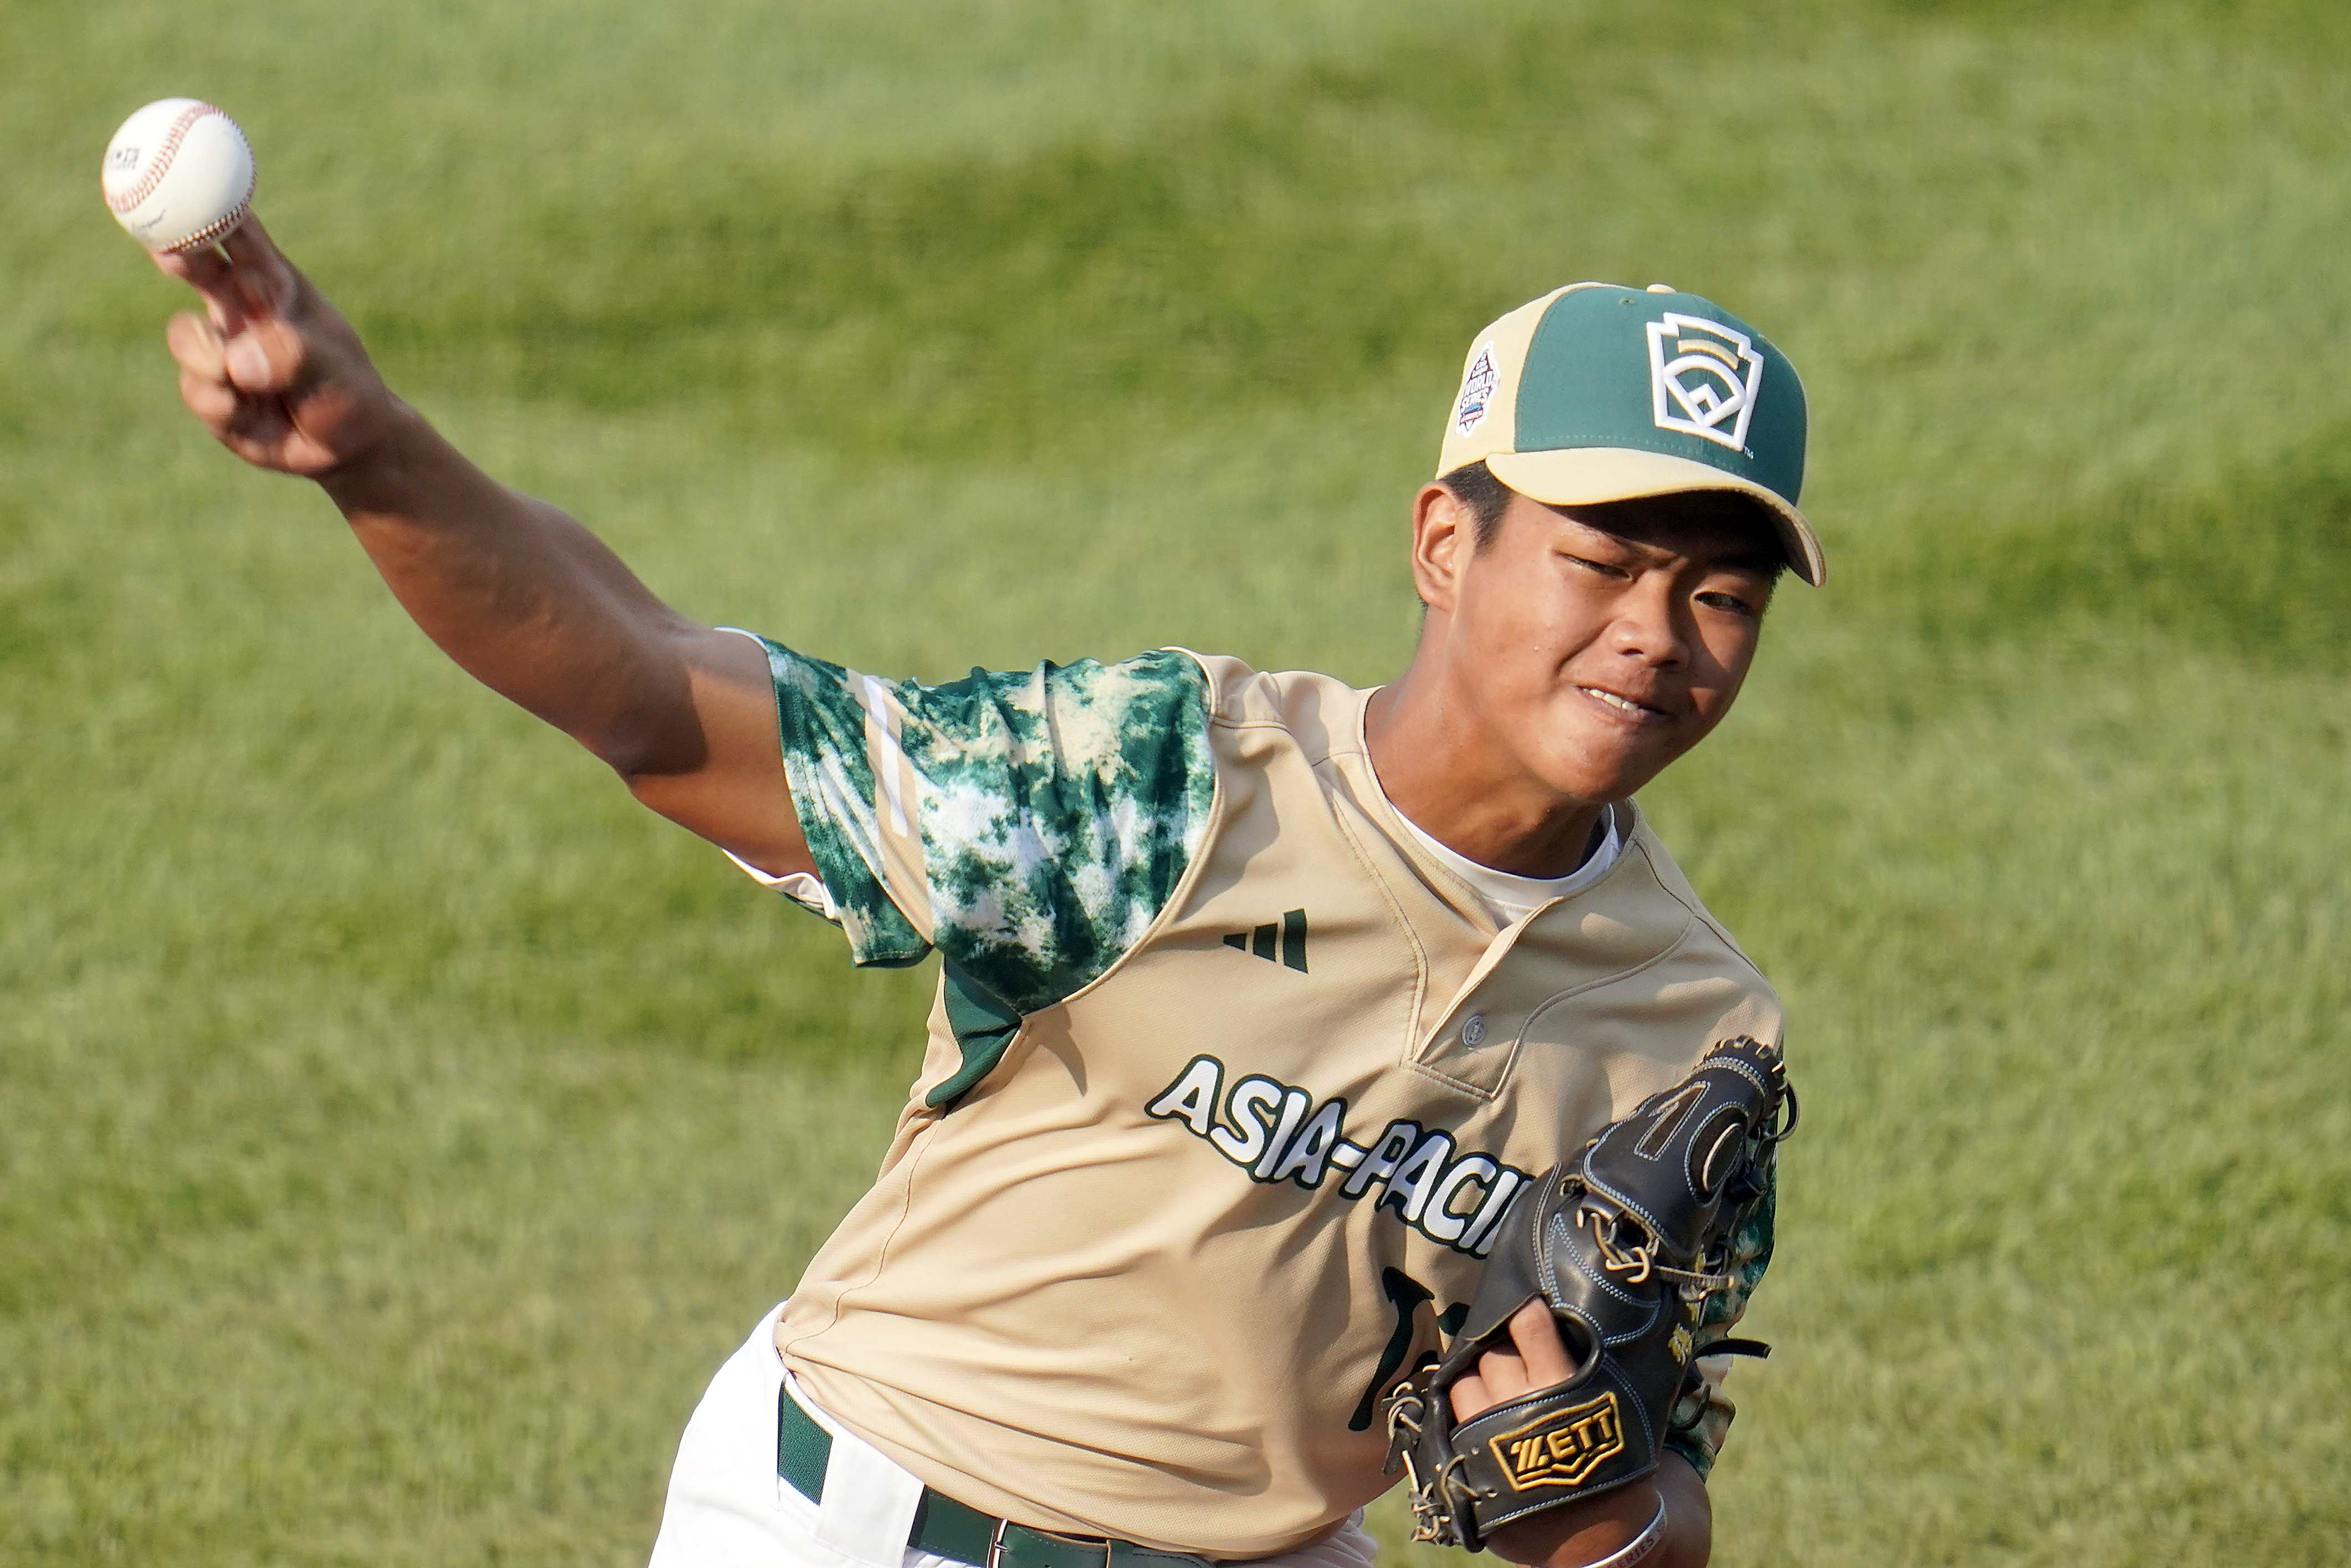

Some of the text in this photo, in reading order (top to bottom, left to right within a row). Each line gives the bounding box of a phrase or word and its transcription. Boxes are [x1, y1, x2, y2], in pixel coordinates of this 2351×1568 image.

[1463, 370, 1493, 397] WORLD
[1460, 387, 1490, 414] SERIES
[1510, 1406, 1612, 1473] ZETT
[1607, 1534, 1655, 1568] ERIES
